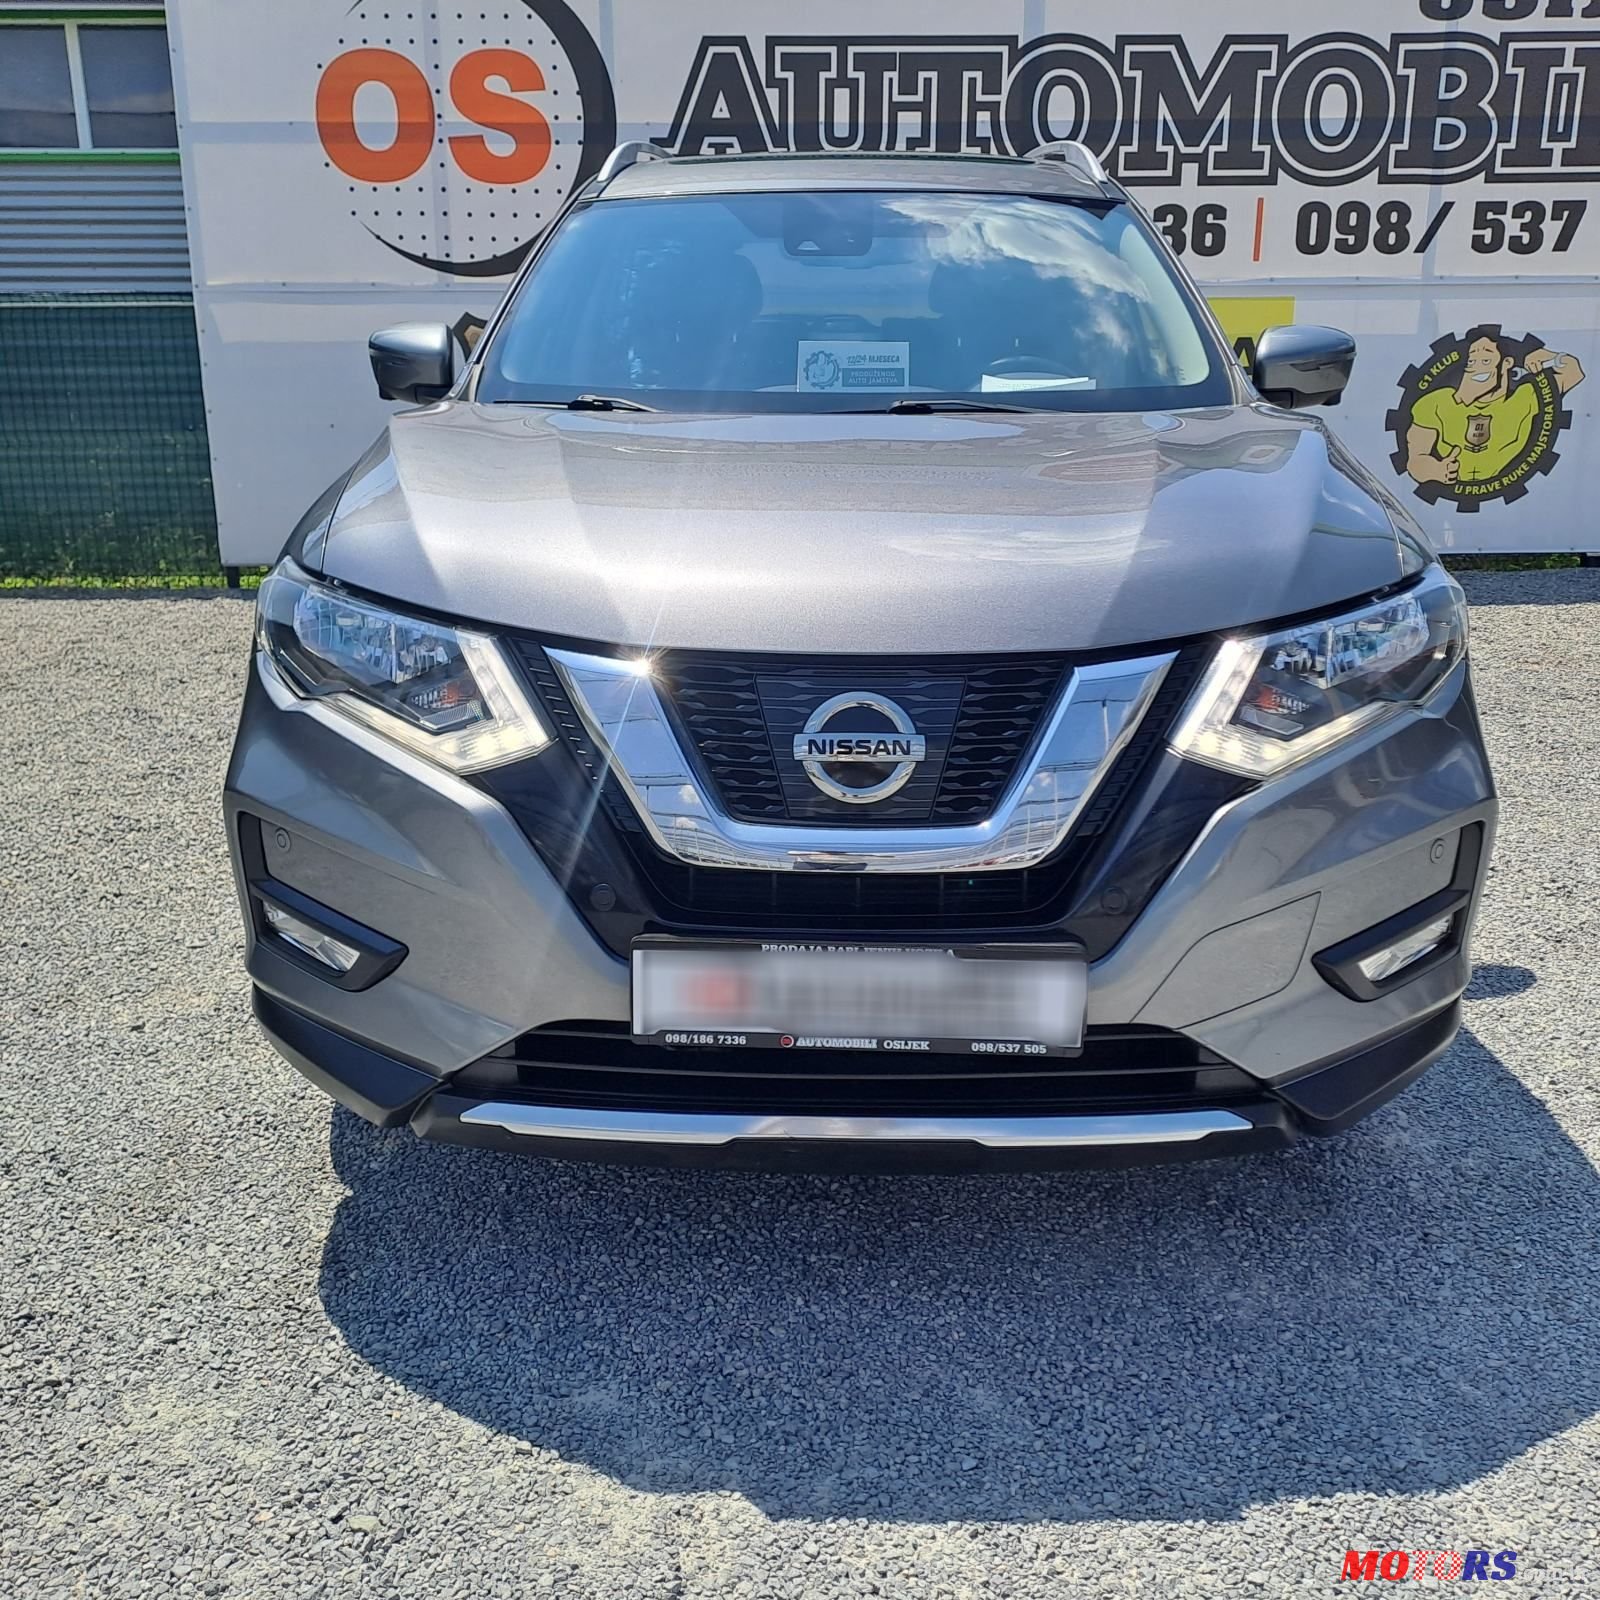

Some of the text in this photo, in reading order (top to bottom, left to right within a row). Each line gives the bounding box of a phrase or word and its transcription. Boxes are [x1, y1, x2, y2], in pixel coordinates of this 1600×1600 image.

[316, 47, 551, 184] OS
[1471, 200, 1588, 255] 537
[1418, 351, 1460, 390] G1 KLUB
[1454, 485, 1463, 494] U
[1465, 481, 1501, 495] PRAVE
[1502, 462, 1530, 486] RUKE
[1527, 404, 1554, 464] MAJSTORA
[807, 739, 911, 755] NISSAN
[665, 1033, 714, 1045] 098/186
[717, 1034, 747, 1045] 7336
[883, 1040, 930, 1050] OSIJEK
[971, 1042, 1021, 1054] 098/537
[1024, 1045, 1047, 1055] 505
